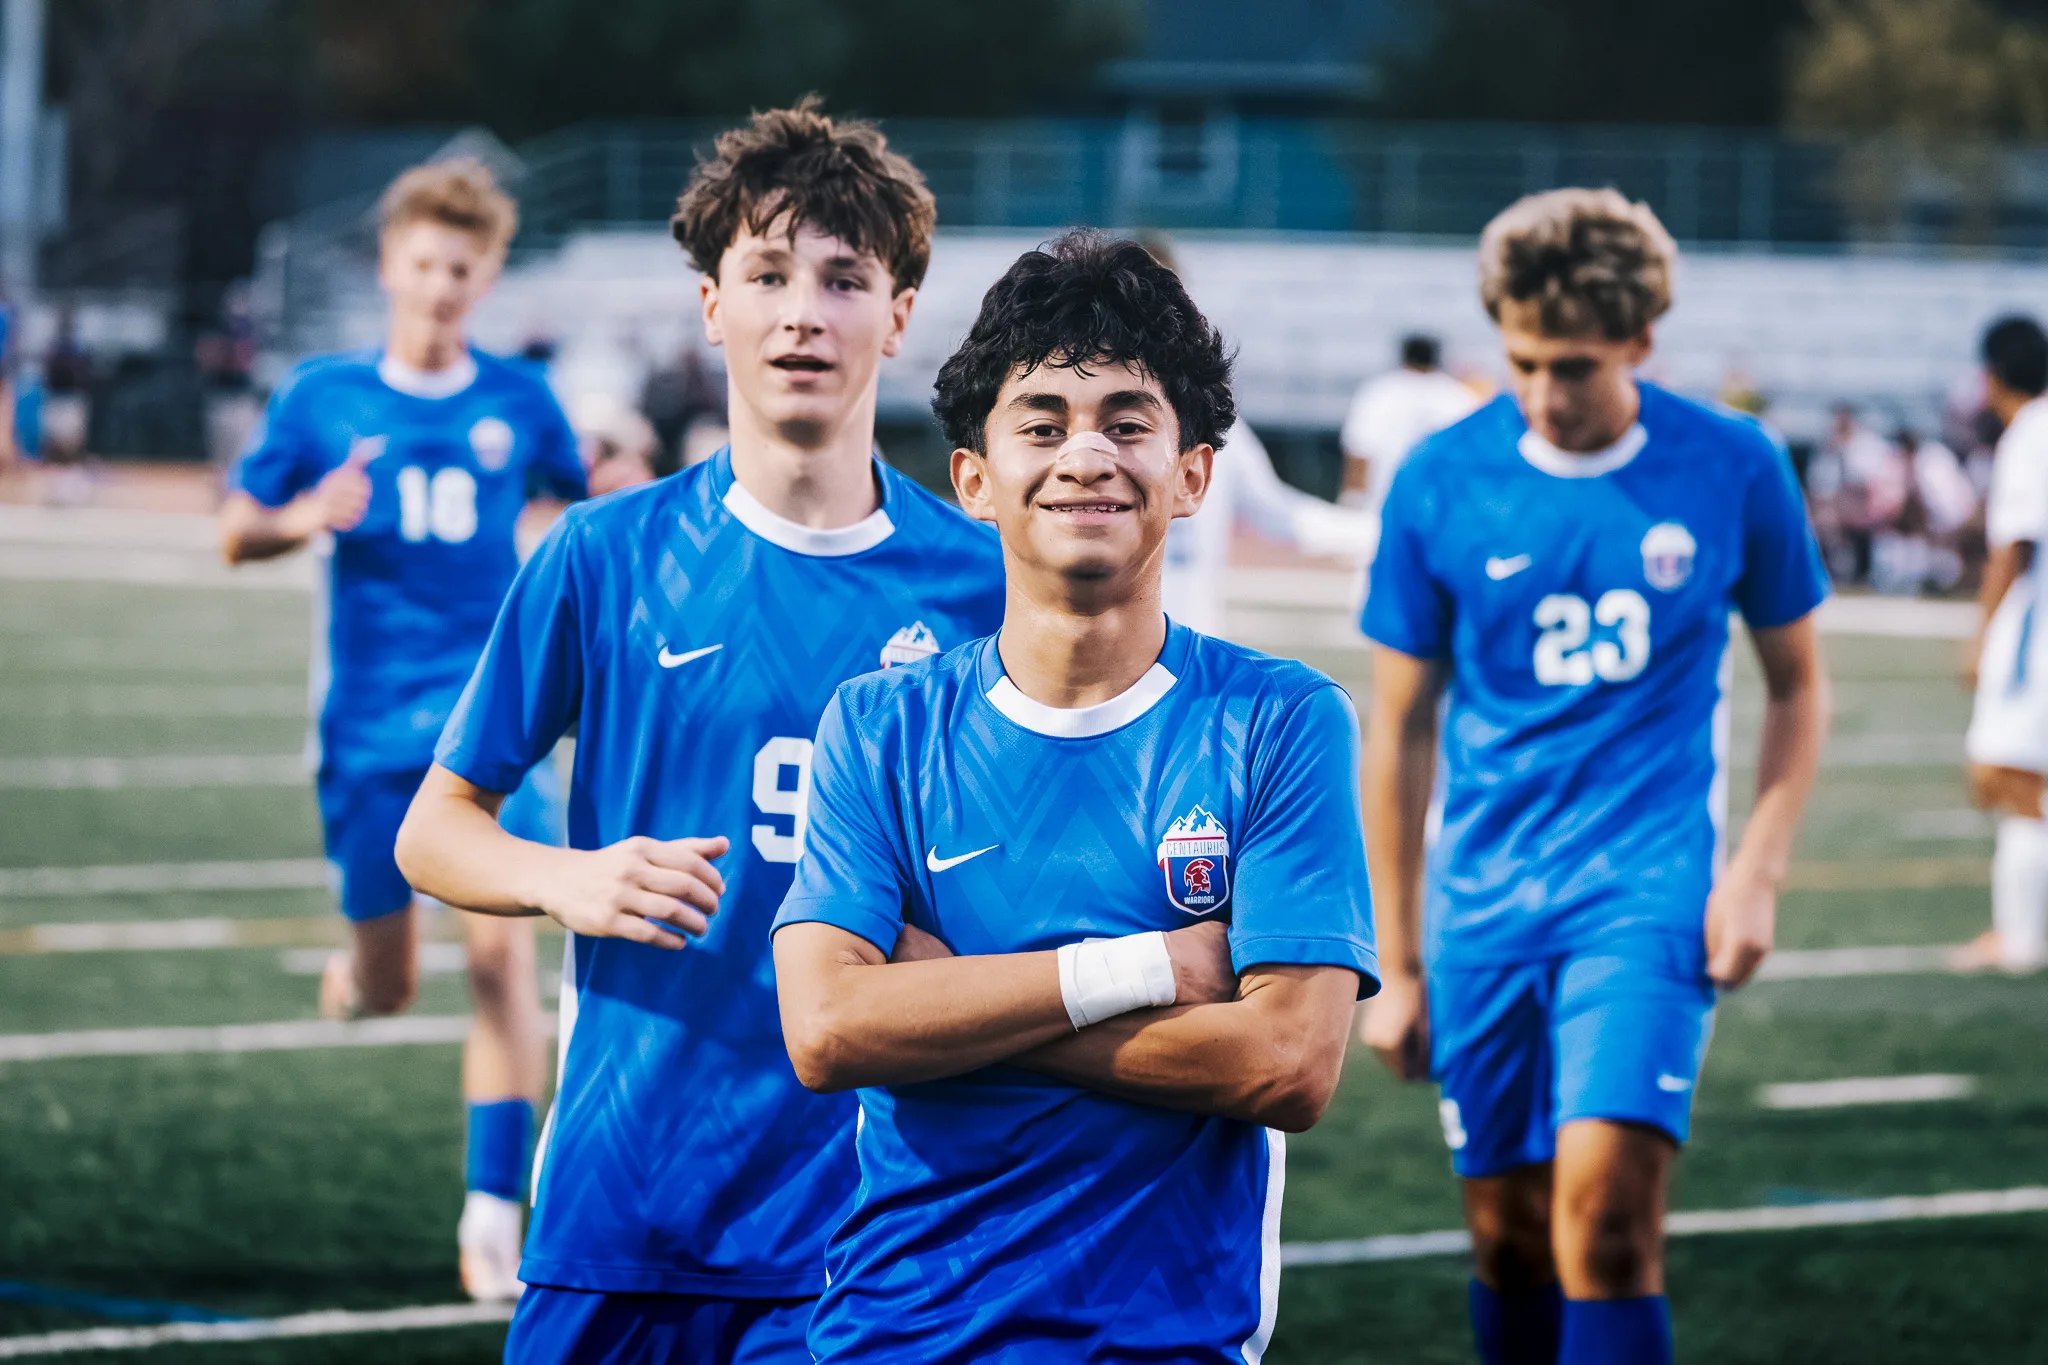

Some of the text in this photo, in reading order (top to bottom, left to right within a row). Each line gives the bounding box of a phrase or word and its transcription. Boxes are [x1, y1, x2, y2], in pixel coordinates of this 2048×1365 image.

[1533, 589, 1650, 686] 23
[752, 736, 814, 864] 9
[1166, 841, 1225, 856] CENTAURUS
[1184, 896, 1215, 905] WARRIORS
